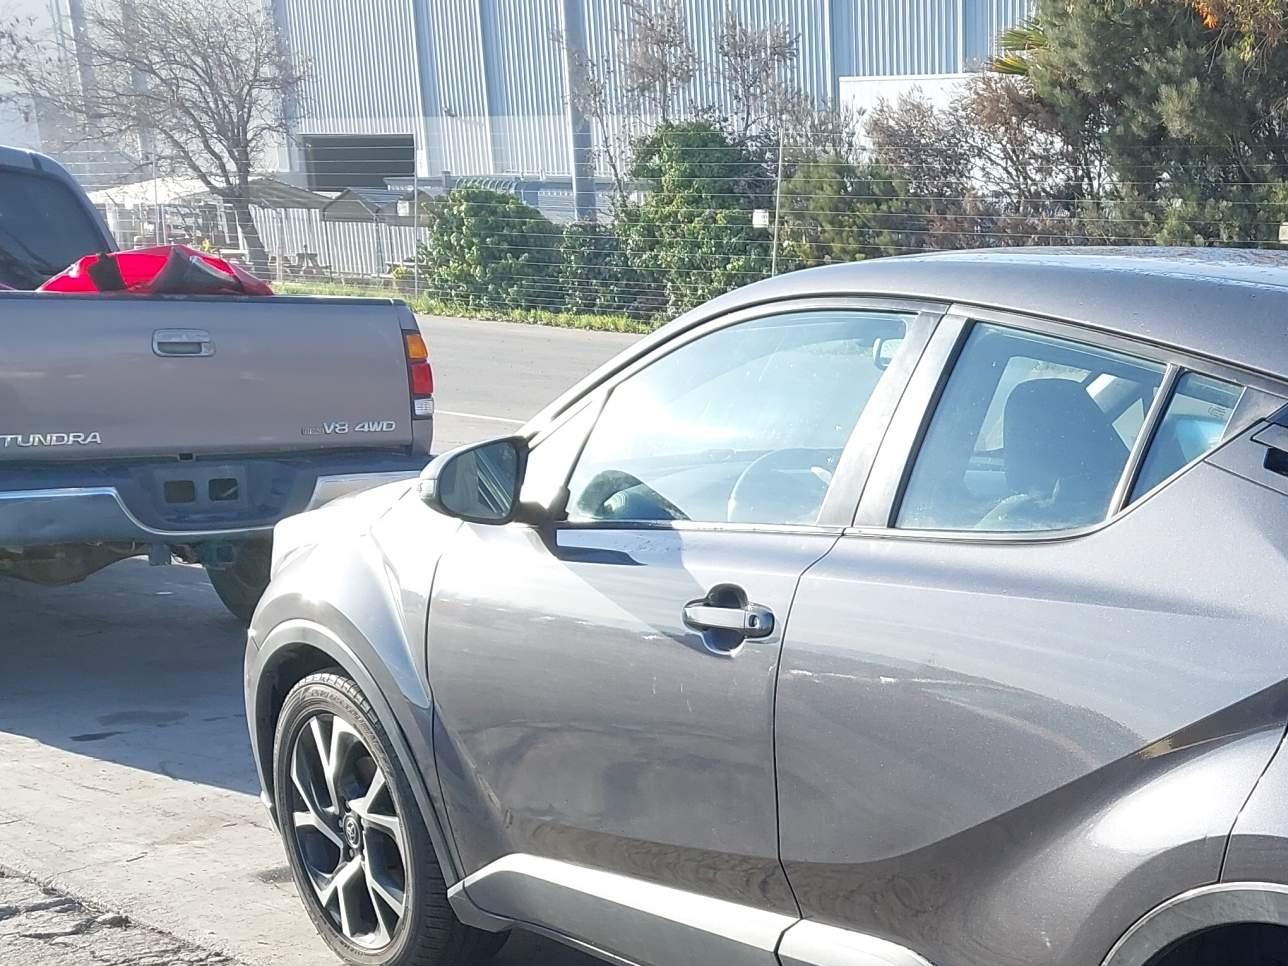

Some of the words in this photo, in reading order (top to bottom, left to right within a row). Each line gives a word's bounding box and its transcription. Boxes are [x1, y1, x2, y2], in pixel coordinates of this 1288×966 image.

[323, 422, 349, 435] V8
[354, 421, 396, 433] 4WD
[0, 432, 103, 448] TUNDRA
